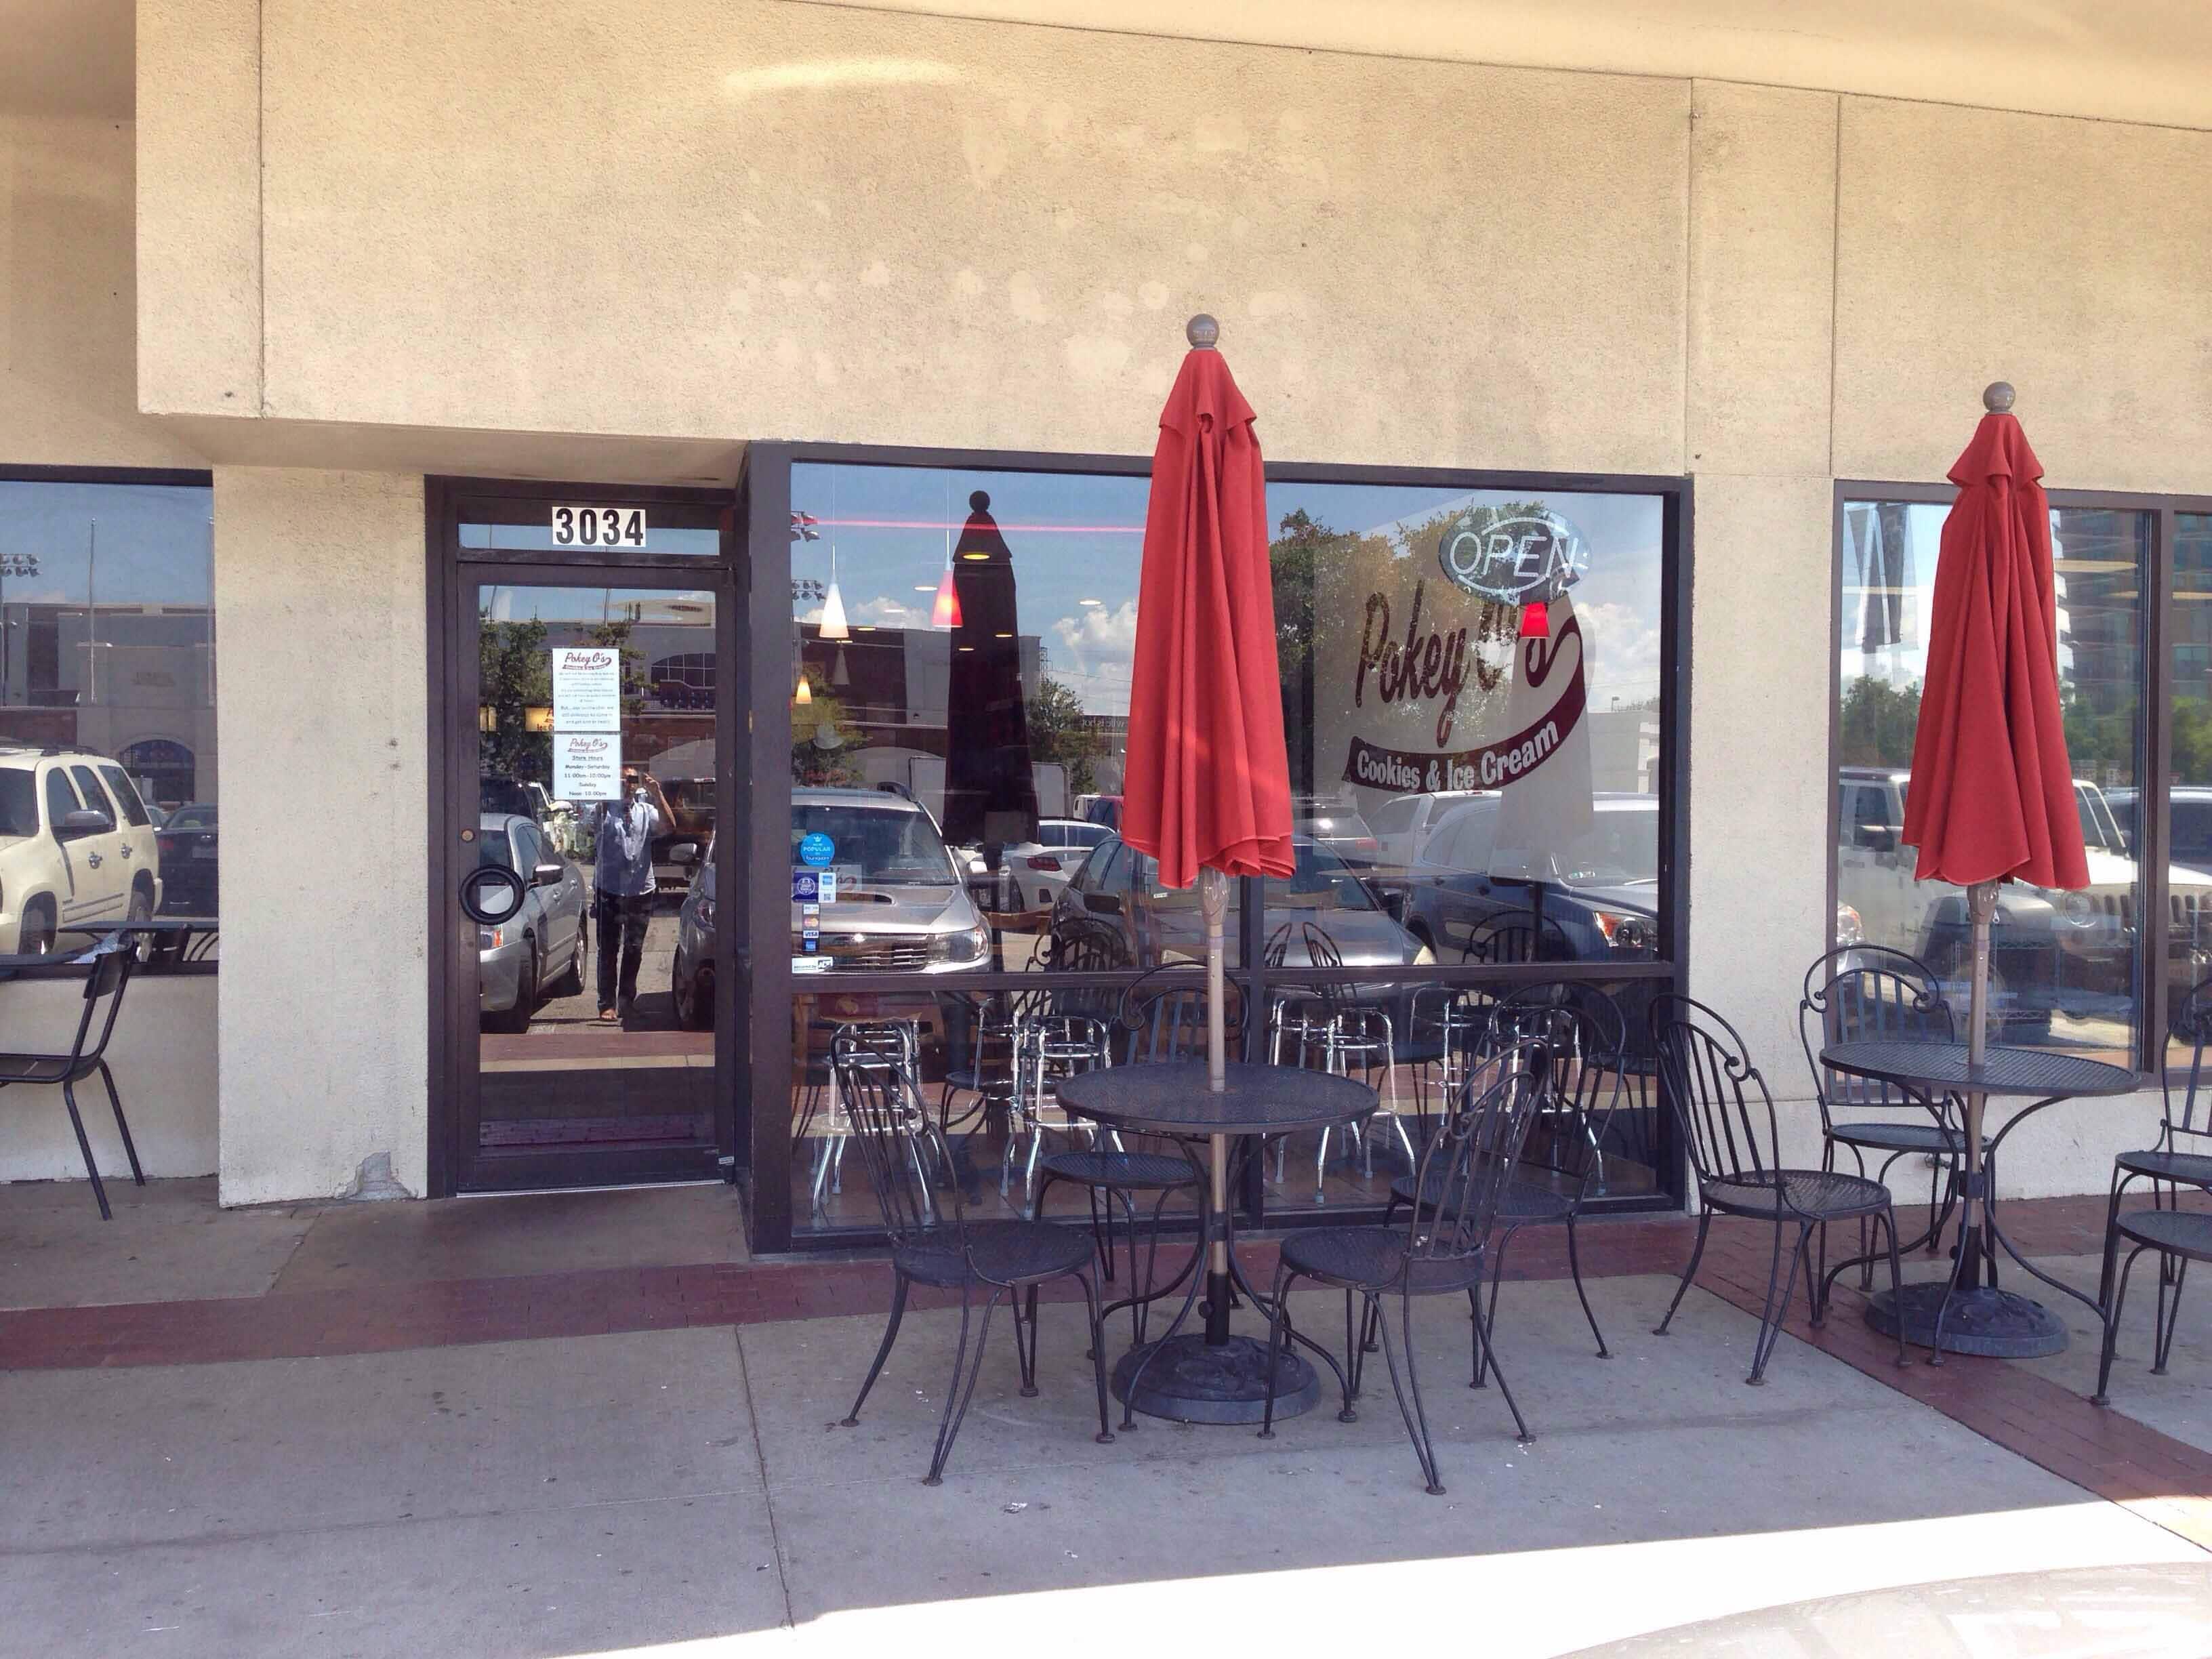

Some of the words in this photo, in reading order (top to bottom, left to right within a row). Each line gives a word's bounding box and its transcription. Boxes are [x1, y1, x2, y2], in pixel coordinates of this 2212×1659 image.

[555, 508, 643, 546] 3034
[1450, 531, 1578, 577] OPEN
[565, 652, 591, 666] Pokey
[1355, 579, 1469, 748] Pokey
[1357, 750, 1420, 789] Cookies
[1426, 759, 1441, 792] &
[1447, 759, 1474, 790] Ice
[1481, 721, 1559, 785] Cream
